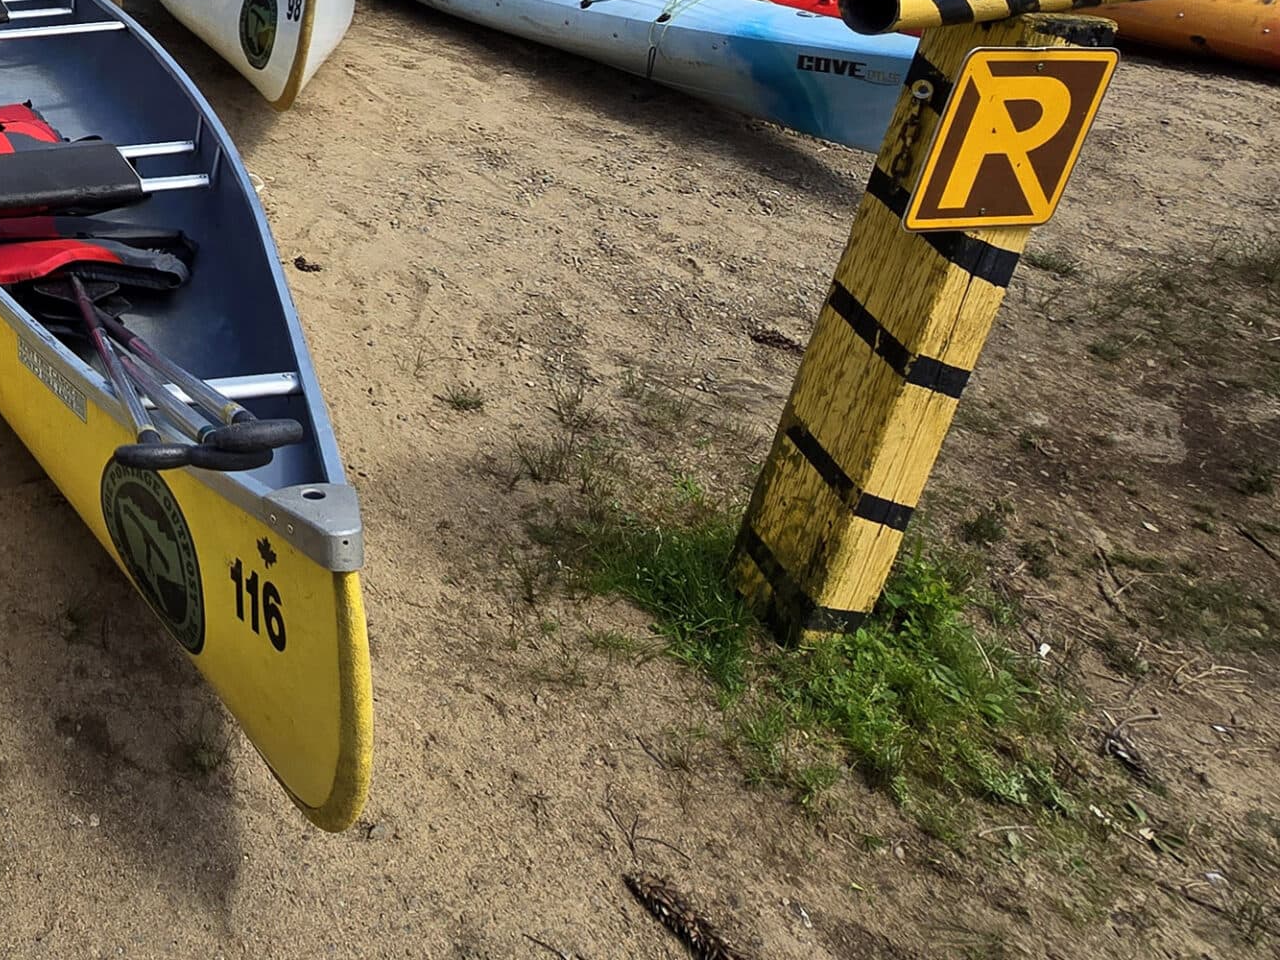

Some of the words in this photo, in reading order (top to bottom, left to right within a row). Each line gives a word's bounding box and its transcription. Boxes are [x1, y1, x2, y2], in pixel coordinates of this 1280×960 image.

[797, 54, 867, 78] COVE
[163, 495, 199, 607] OUTPOST
[229, 557, 287, 652] 116
